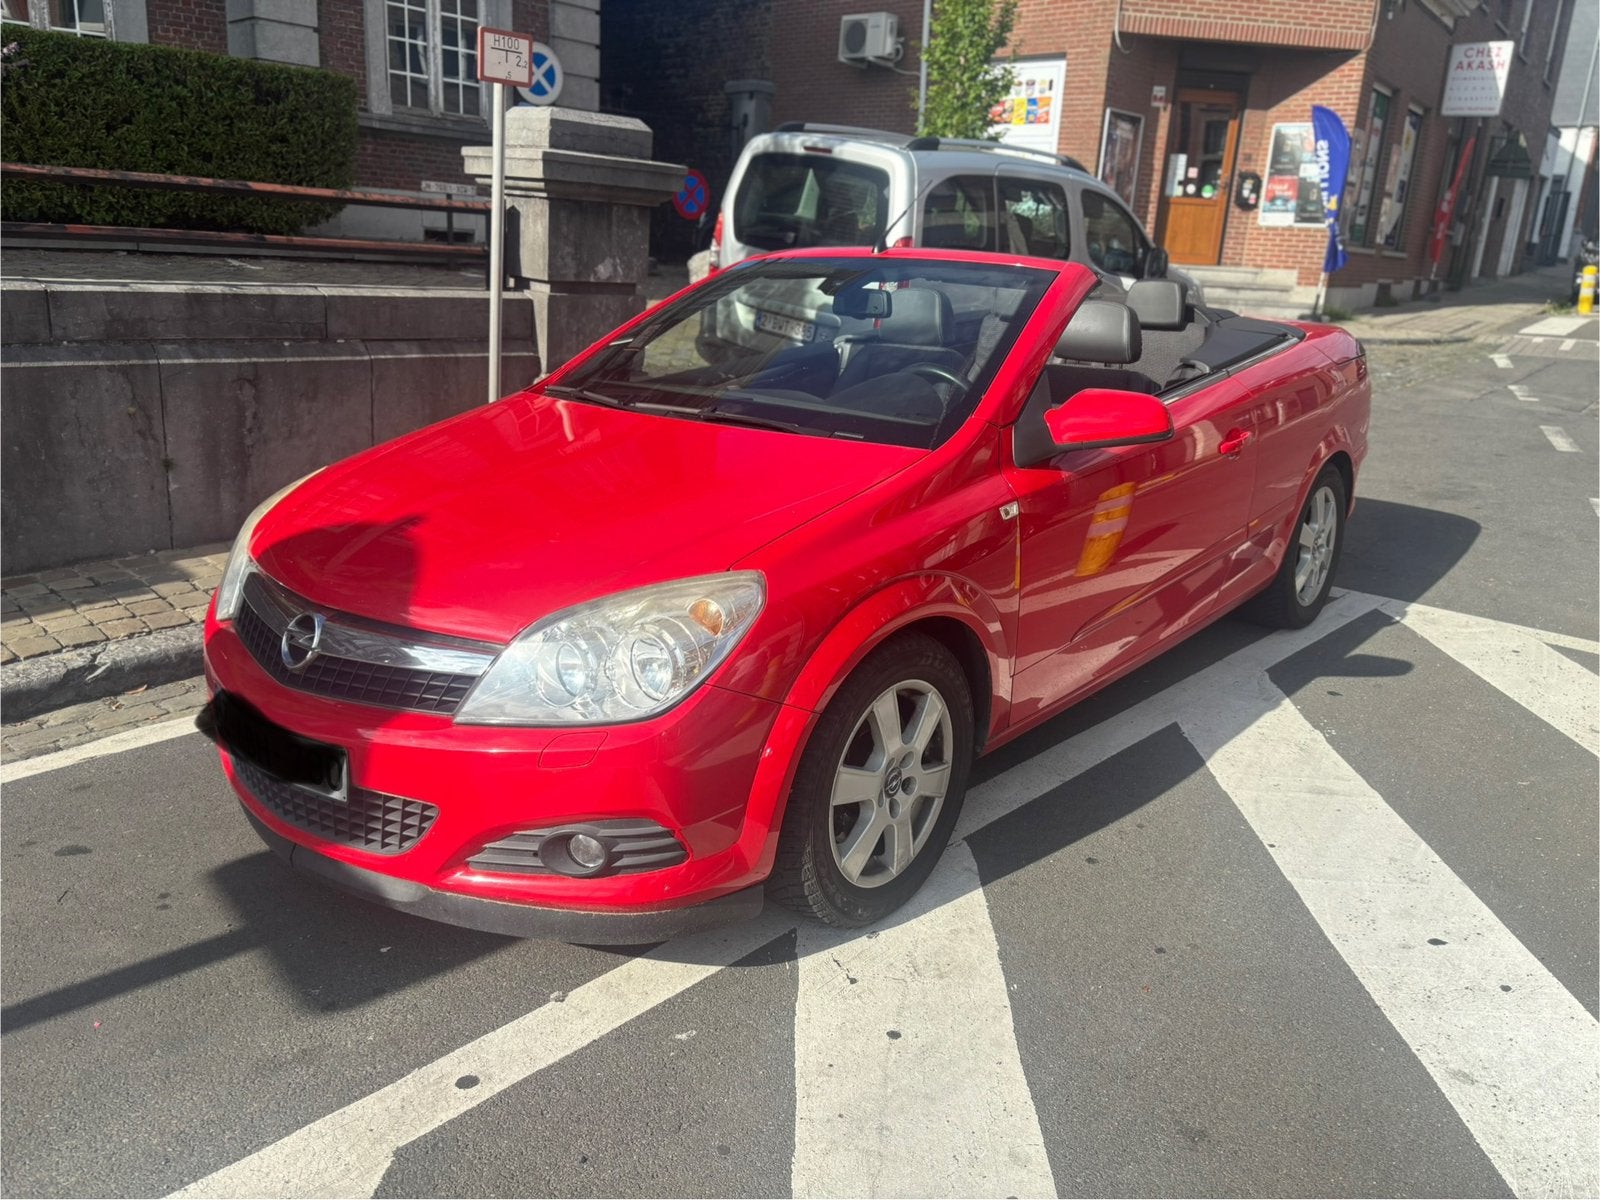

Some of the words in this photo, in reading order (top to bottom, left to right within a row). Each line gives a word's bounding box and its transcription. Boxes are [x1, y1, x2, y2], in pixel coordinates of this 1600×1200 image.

[493, 34, 520, 51] H100
[1463, 47, 1504, 59] CHEZ
[1454, 59, 1506, 72] AKASH
